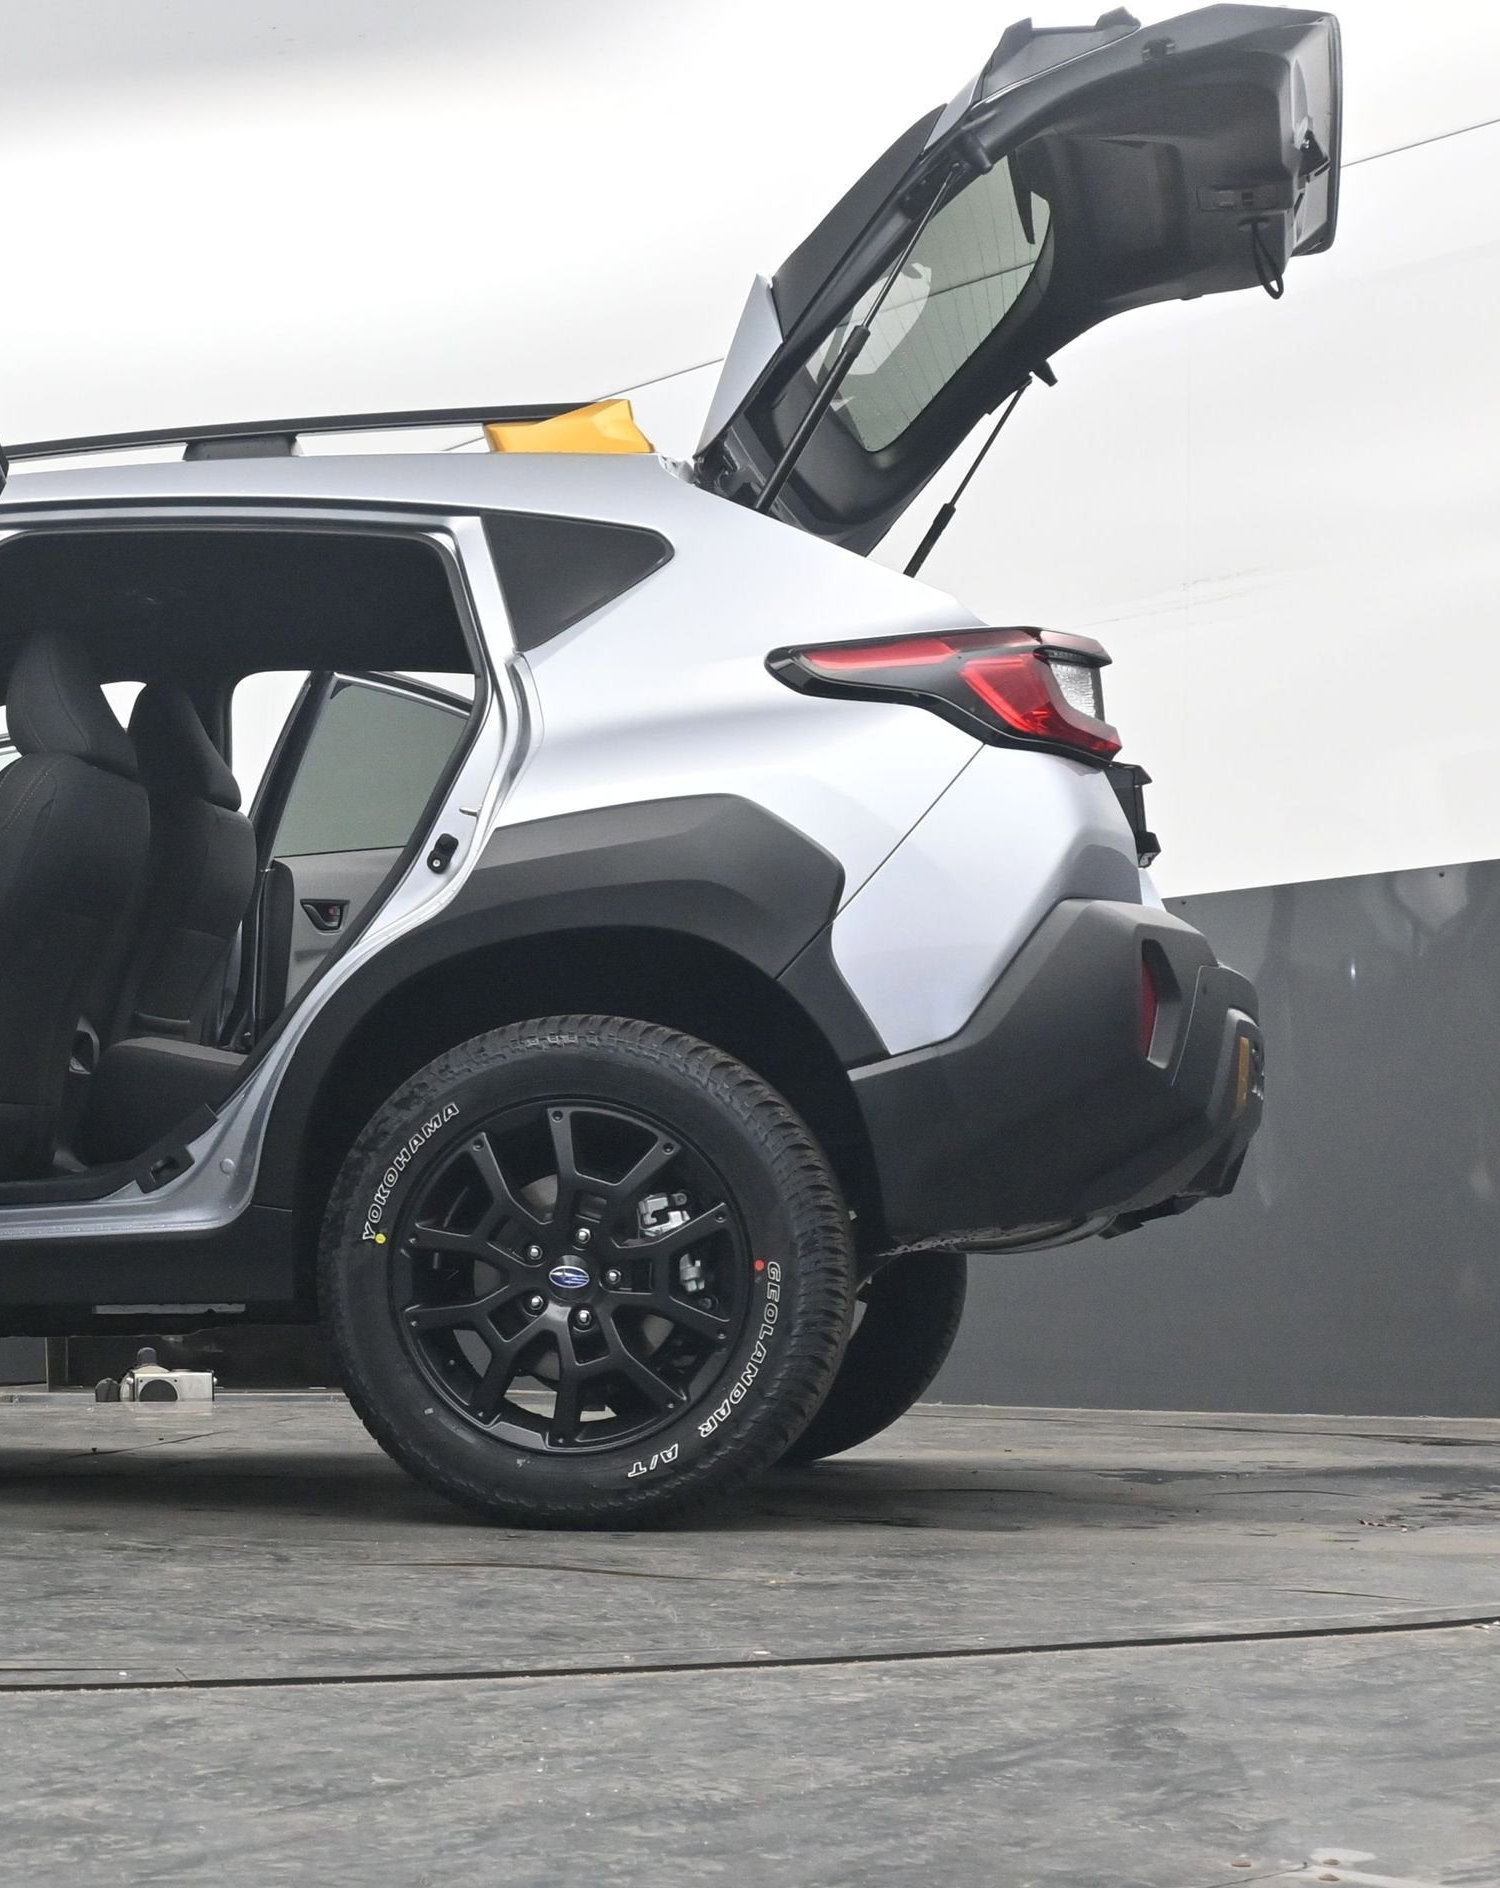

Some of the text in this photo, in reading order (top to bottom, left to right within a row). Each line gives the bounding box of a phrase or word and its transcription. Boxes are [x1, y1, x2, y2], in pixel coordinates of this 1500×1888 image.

[362, 1102, 460, 1240] YOKOHAMA
[627, 1261, 781, 1478] GEOLANDAR A/T
